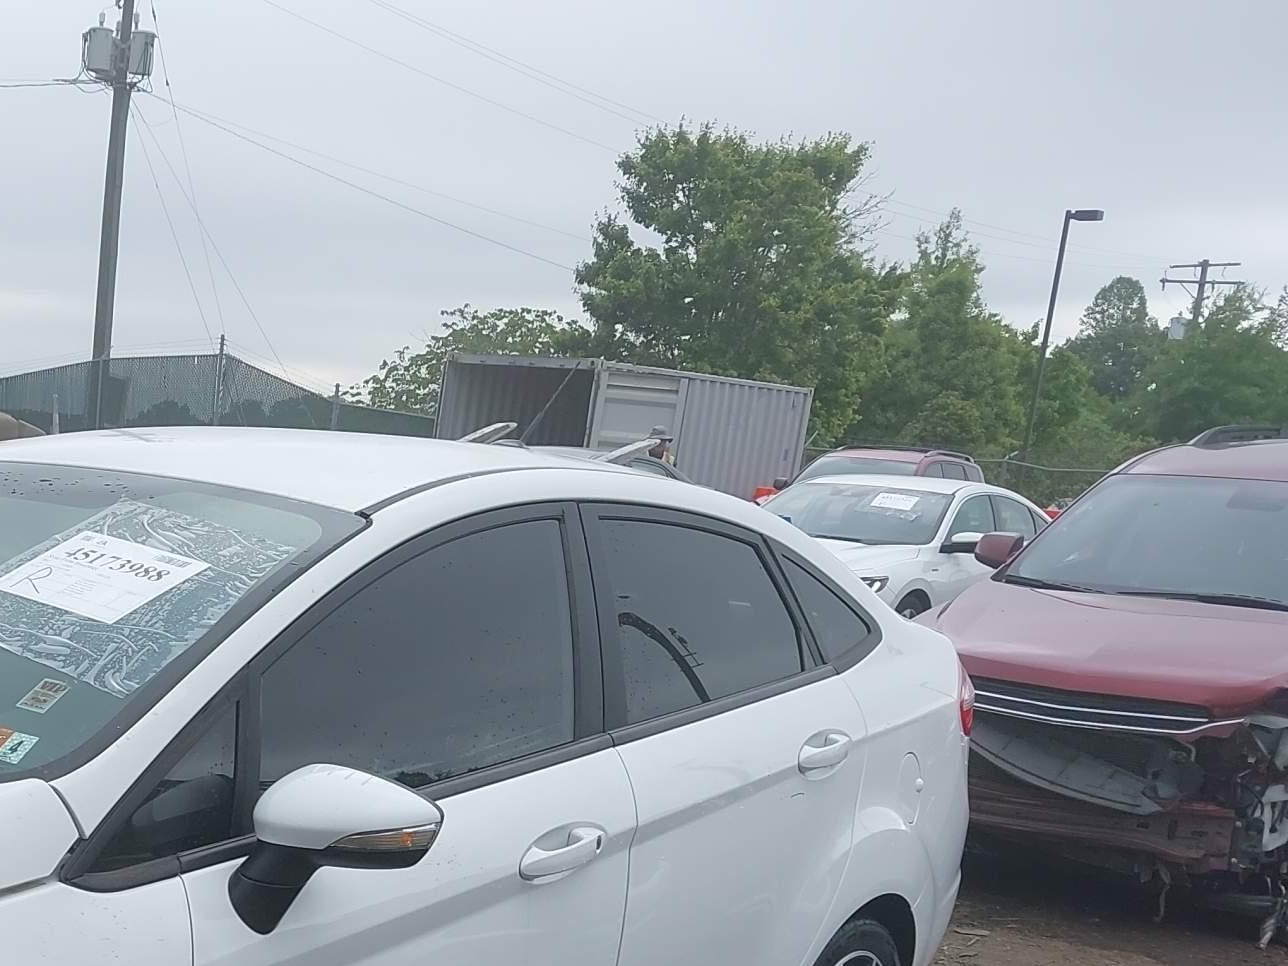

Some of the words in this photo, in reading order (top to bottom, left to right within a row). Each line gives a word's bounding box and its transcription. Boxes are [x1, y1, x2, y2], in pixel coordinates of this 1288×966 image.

[64, 547, 171, 582] 45173988
[9, 566, 53, 594] R
[8, 740, 25, 754] 4
